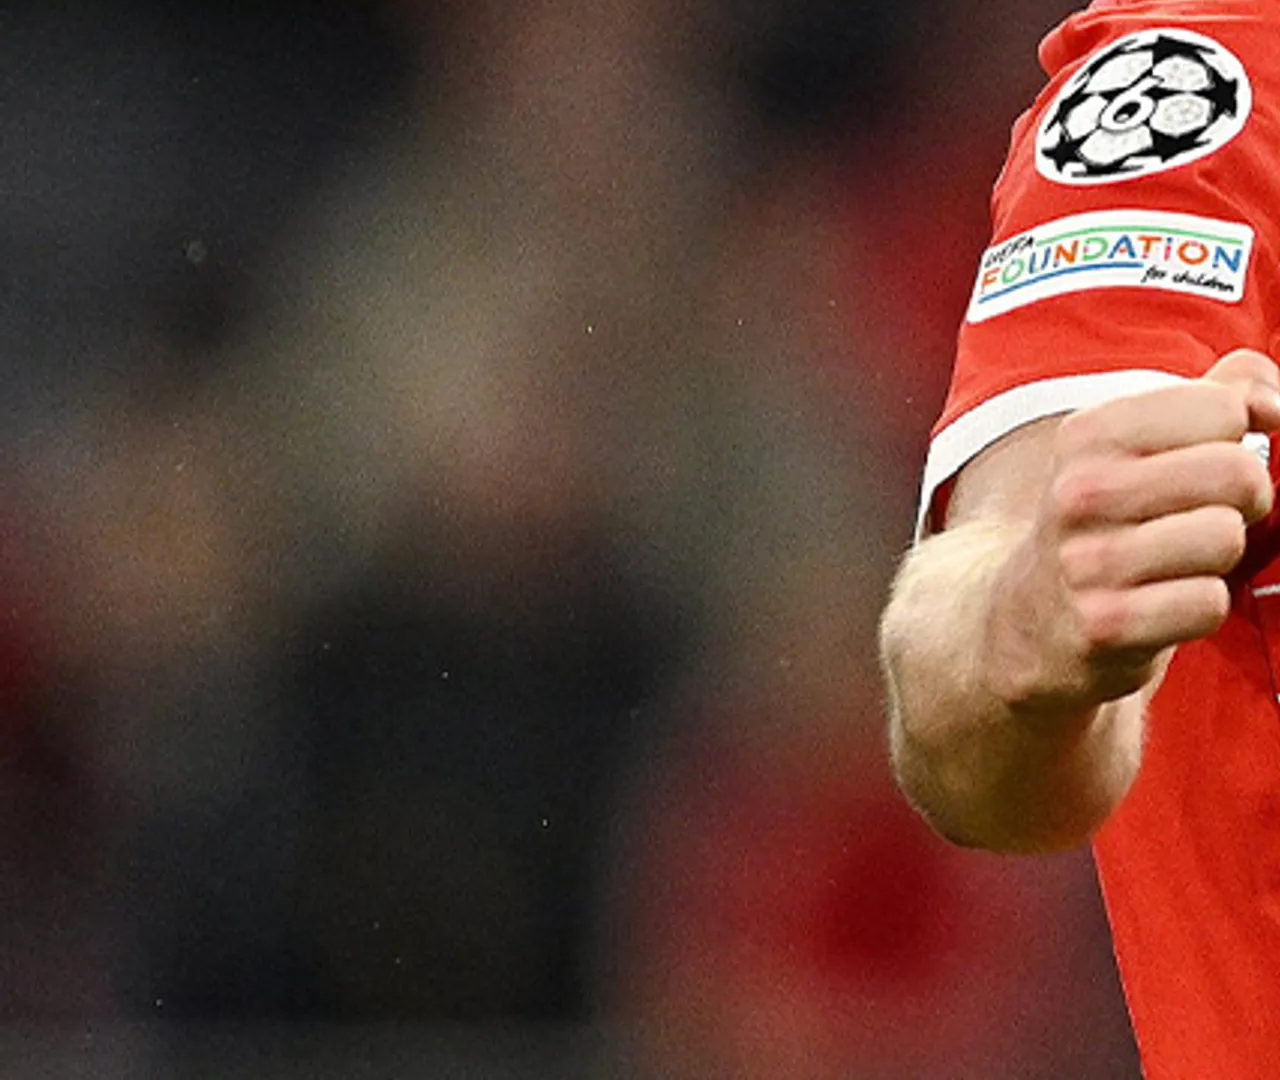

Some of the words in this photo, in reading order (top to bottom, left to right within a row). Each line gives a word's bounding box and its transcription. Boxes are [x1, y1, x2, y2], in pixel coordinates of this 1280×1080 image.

[981, 235, 1242, 294] FOUNDATION
[1141, 265, 1166, 283] for
[1172, 270, 1234, 293] children
